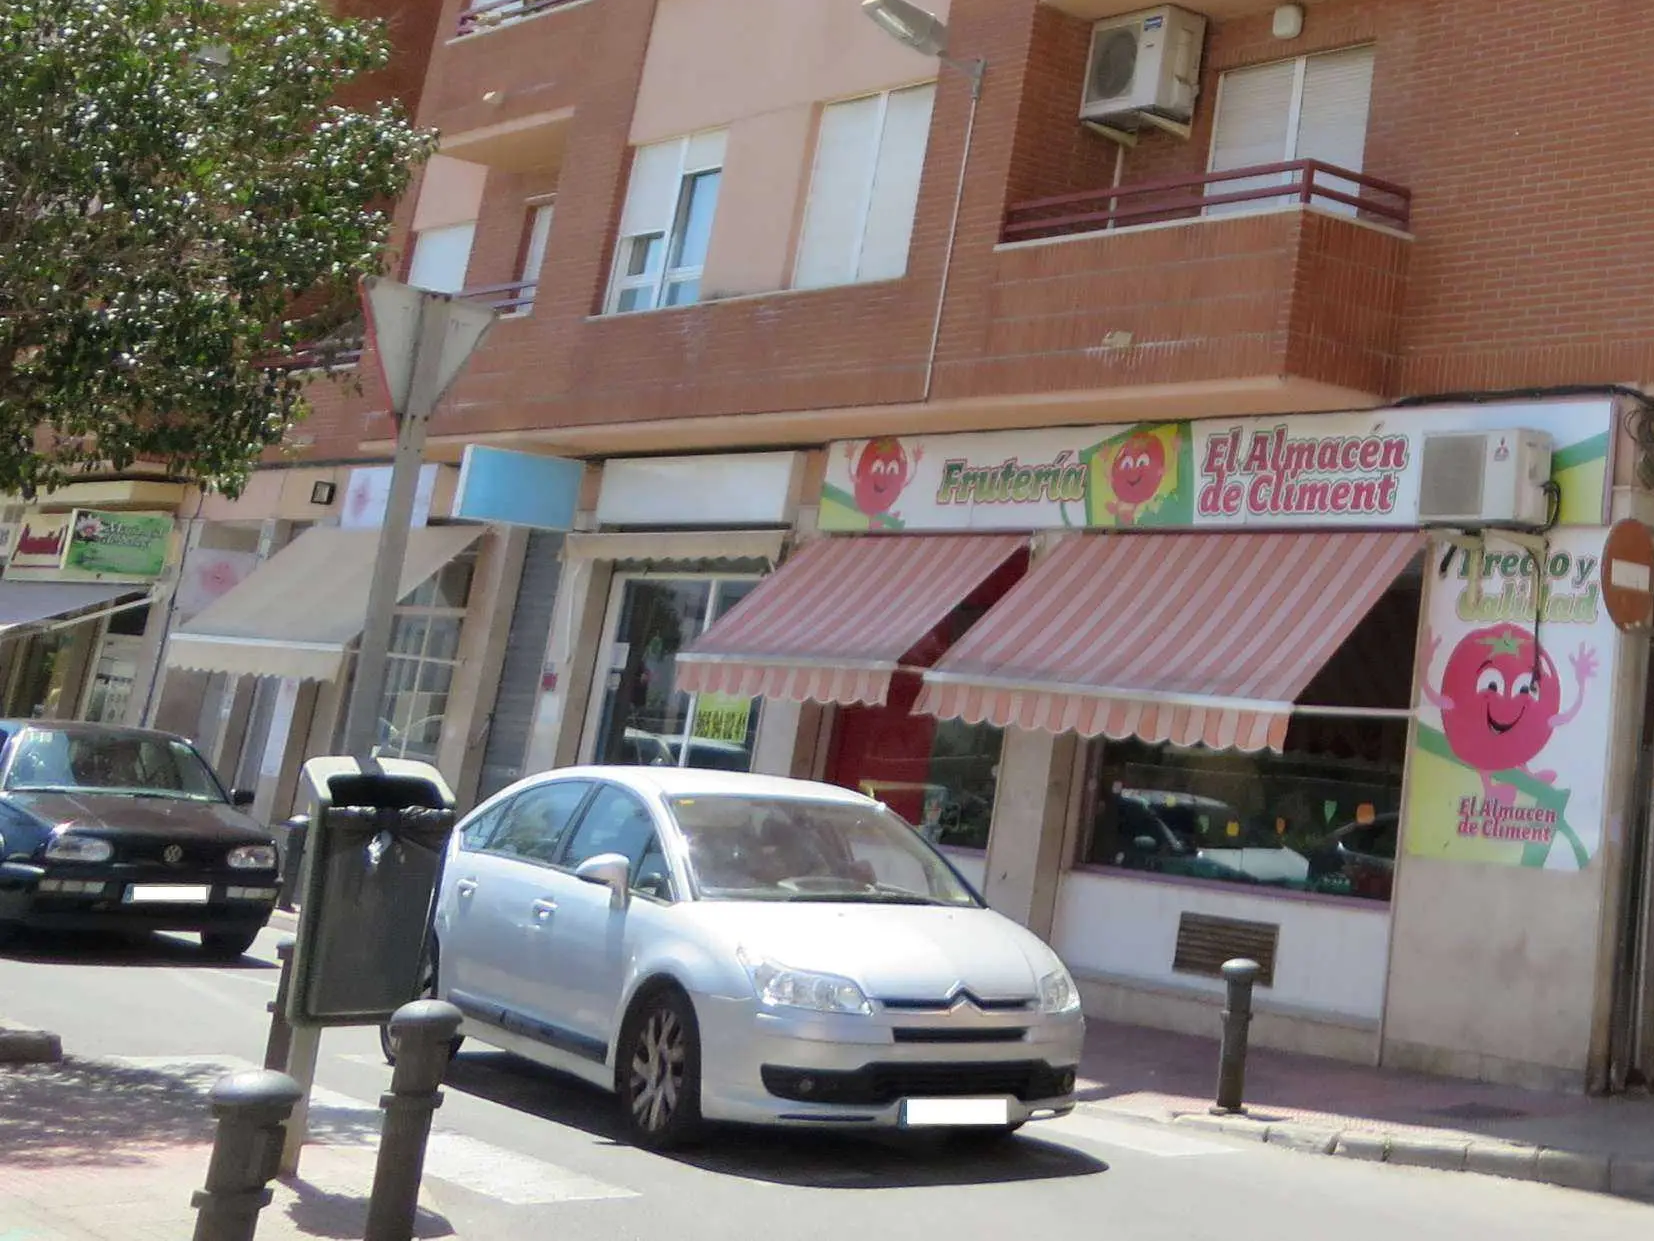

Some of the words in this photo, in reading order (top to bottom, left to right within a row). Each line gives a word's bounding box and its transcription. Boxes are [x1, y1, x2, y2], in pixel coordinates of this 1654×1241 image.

[1202, 426, 1242, 476] El
[1241, 420, 1410, 478] Almacén
[936, 450, 1088, 505] Frutería
[1198, 468, 1245, 517] de
[1247, 467, 1400, 515] Climent
[1457, 546, 1572, 580] reco
[1571, 553, 1598, 588] y
[1457, 815, 1478, 835] de
[1482, 817, 1552, 842] Climent
[1459, 796, 1477, 816] El
